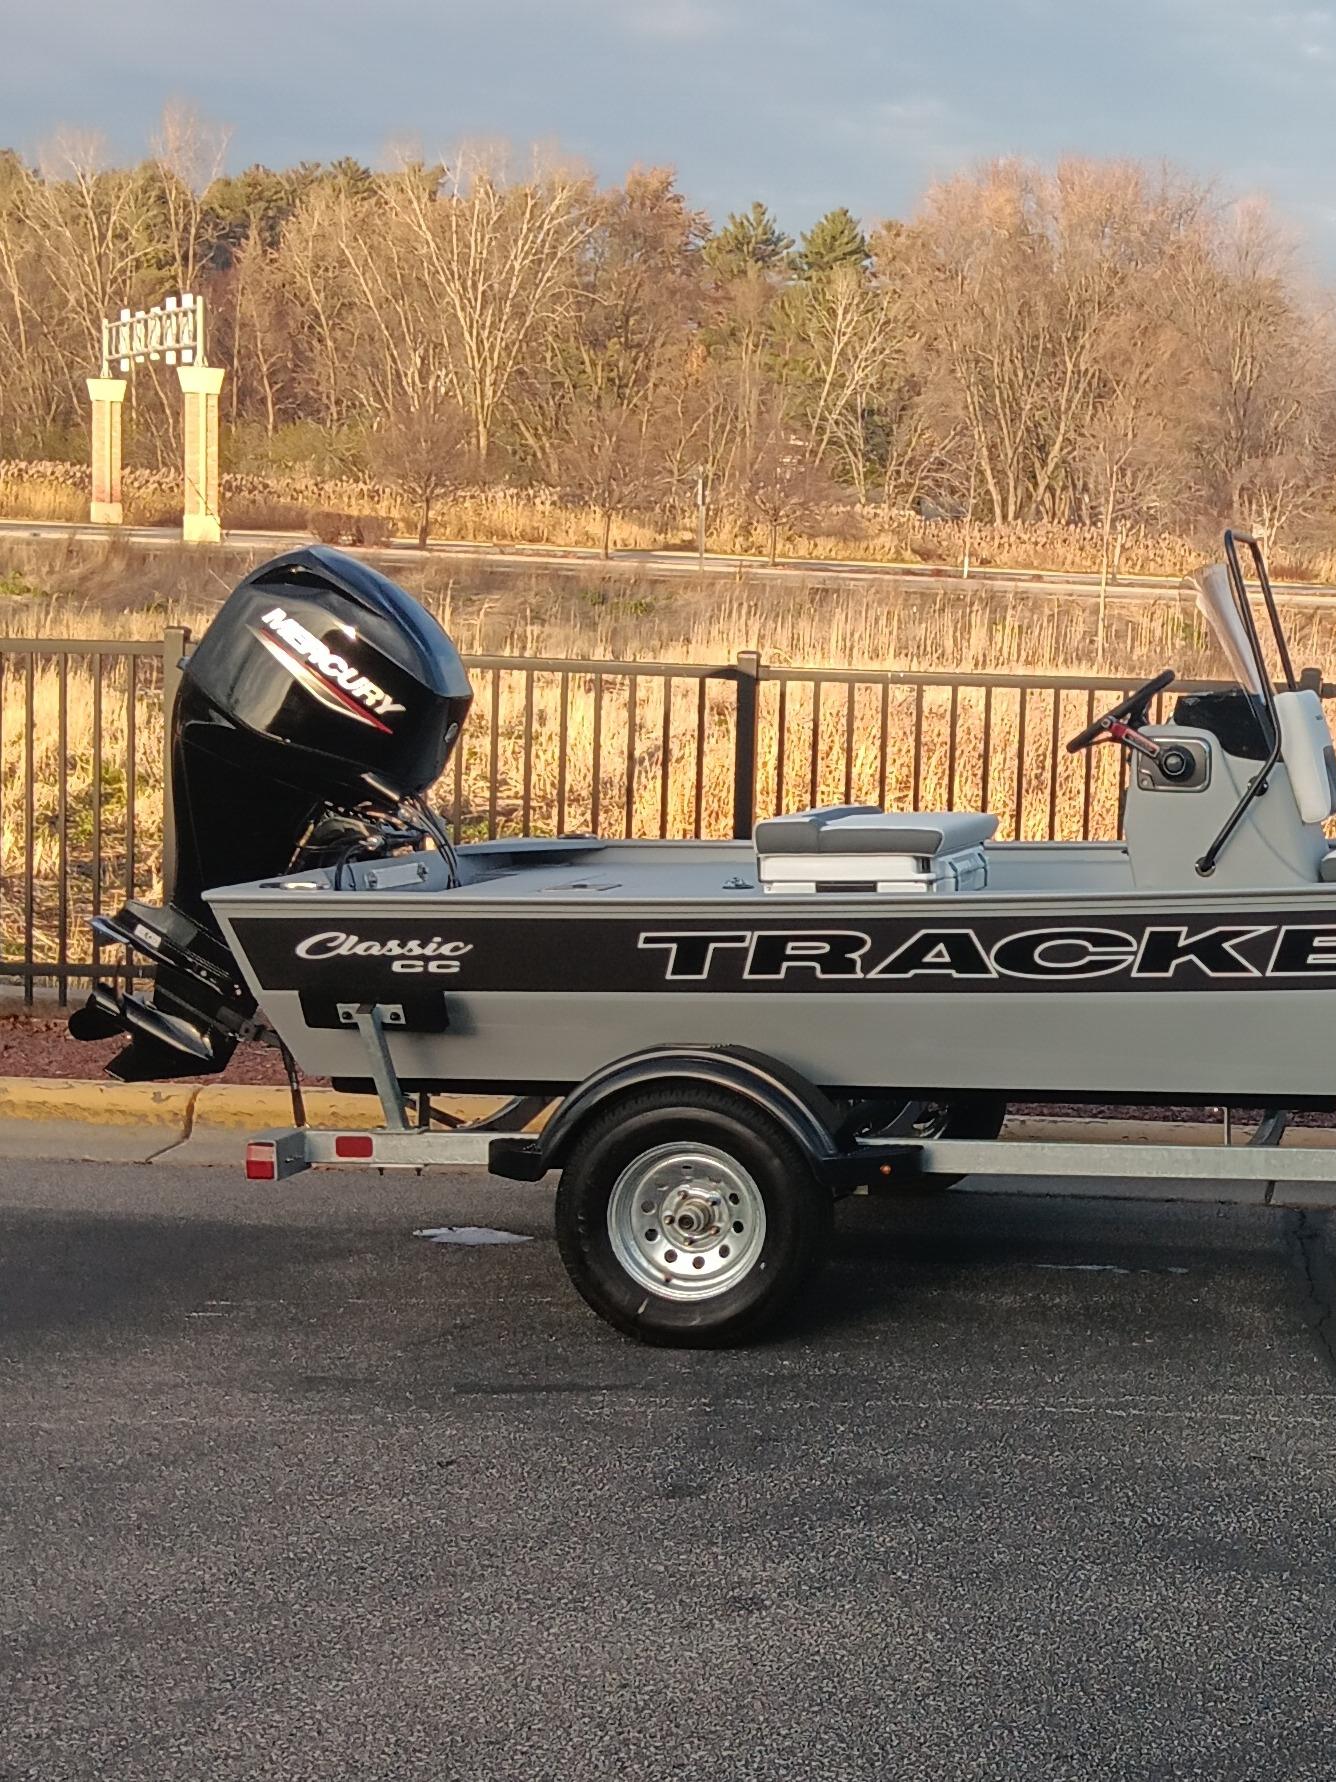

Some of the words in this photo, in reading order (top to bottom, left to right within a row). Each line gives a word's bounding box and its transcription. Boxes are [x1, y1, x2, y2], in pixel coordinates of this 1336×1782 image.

[261, 607, 407, 715] MERCURY
[295, 931, 474, 960] Classic
[391, 960, 461, 973] CC
